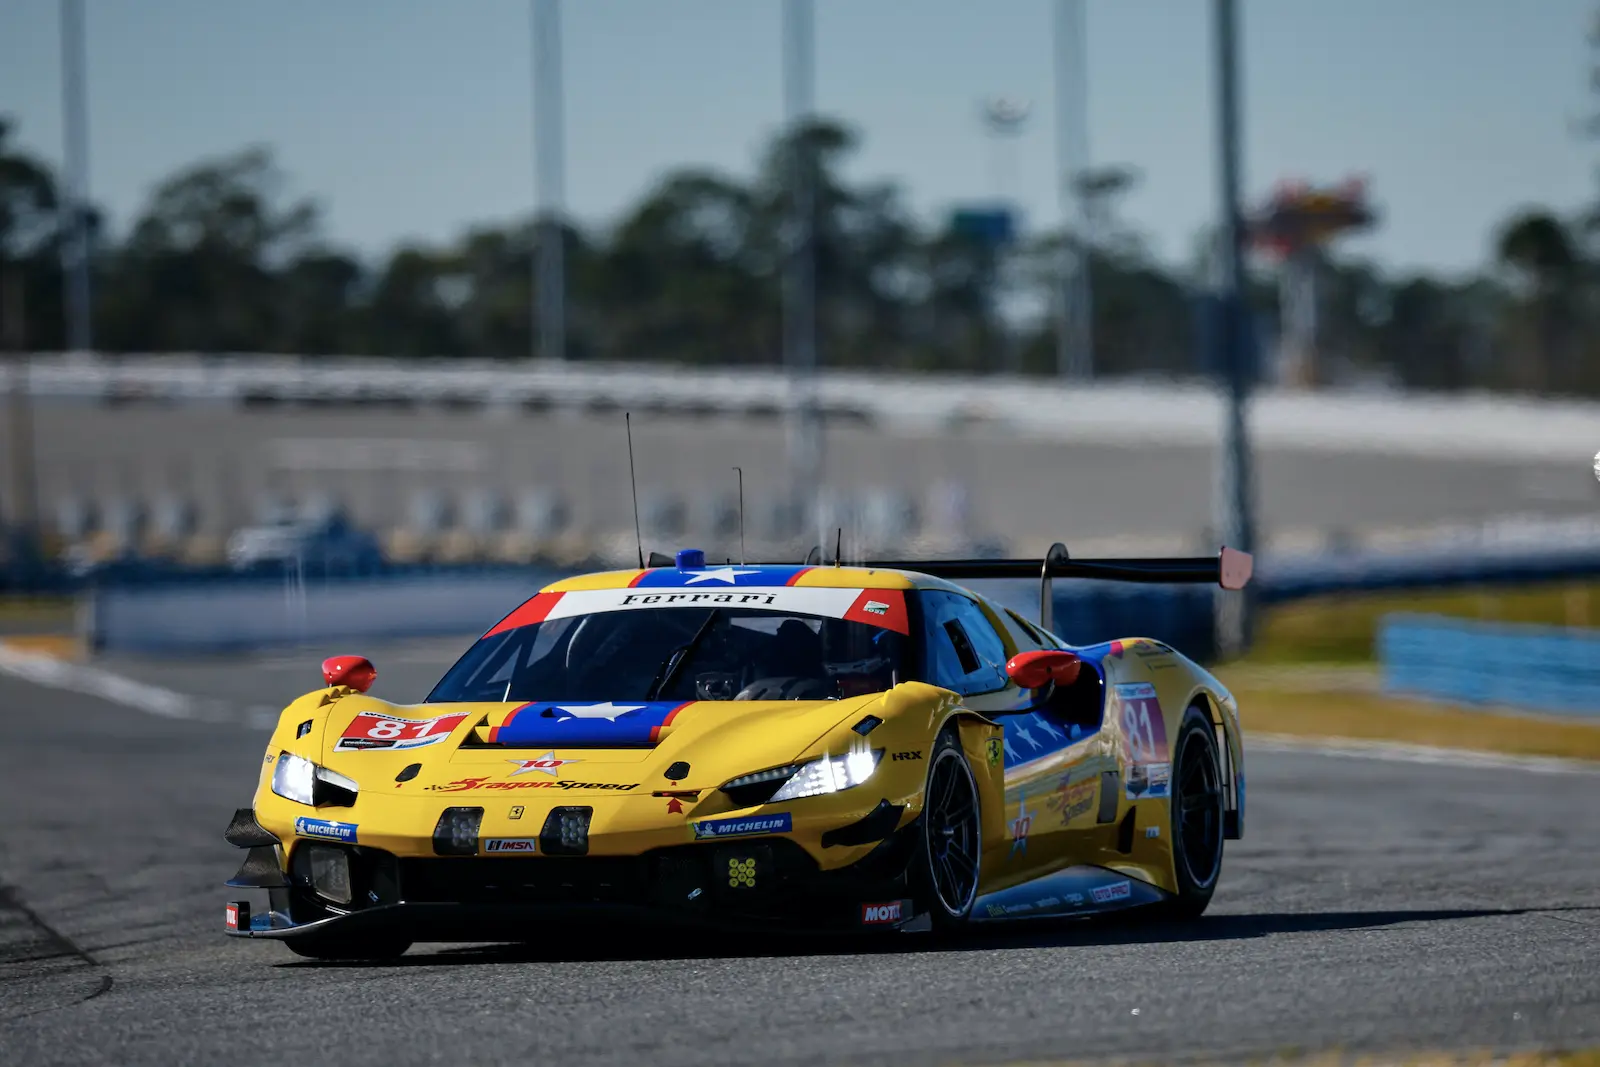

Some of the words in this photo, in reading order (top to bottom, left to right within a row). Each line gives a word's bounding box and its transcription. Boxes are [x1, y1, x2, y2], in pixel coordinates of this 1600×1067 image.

[620, 591, 778, 606] Ferrari
[367, 719, 440, 739] 81
[1124, 700, 1156, 762] 81
[892, 751, 923, 761] HRX
[521, 760, 563, 768] 10
[438, 776, 641, 792] DragonSpeed
[307, 824, 351, 837] MICHELIN
[717, 818, 784, 832] MICHELIN
[1014, 817, 1030, 841] 10
[501, 841, 534, 850] IMSA
